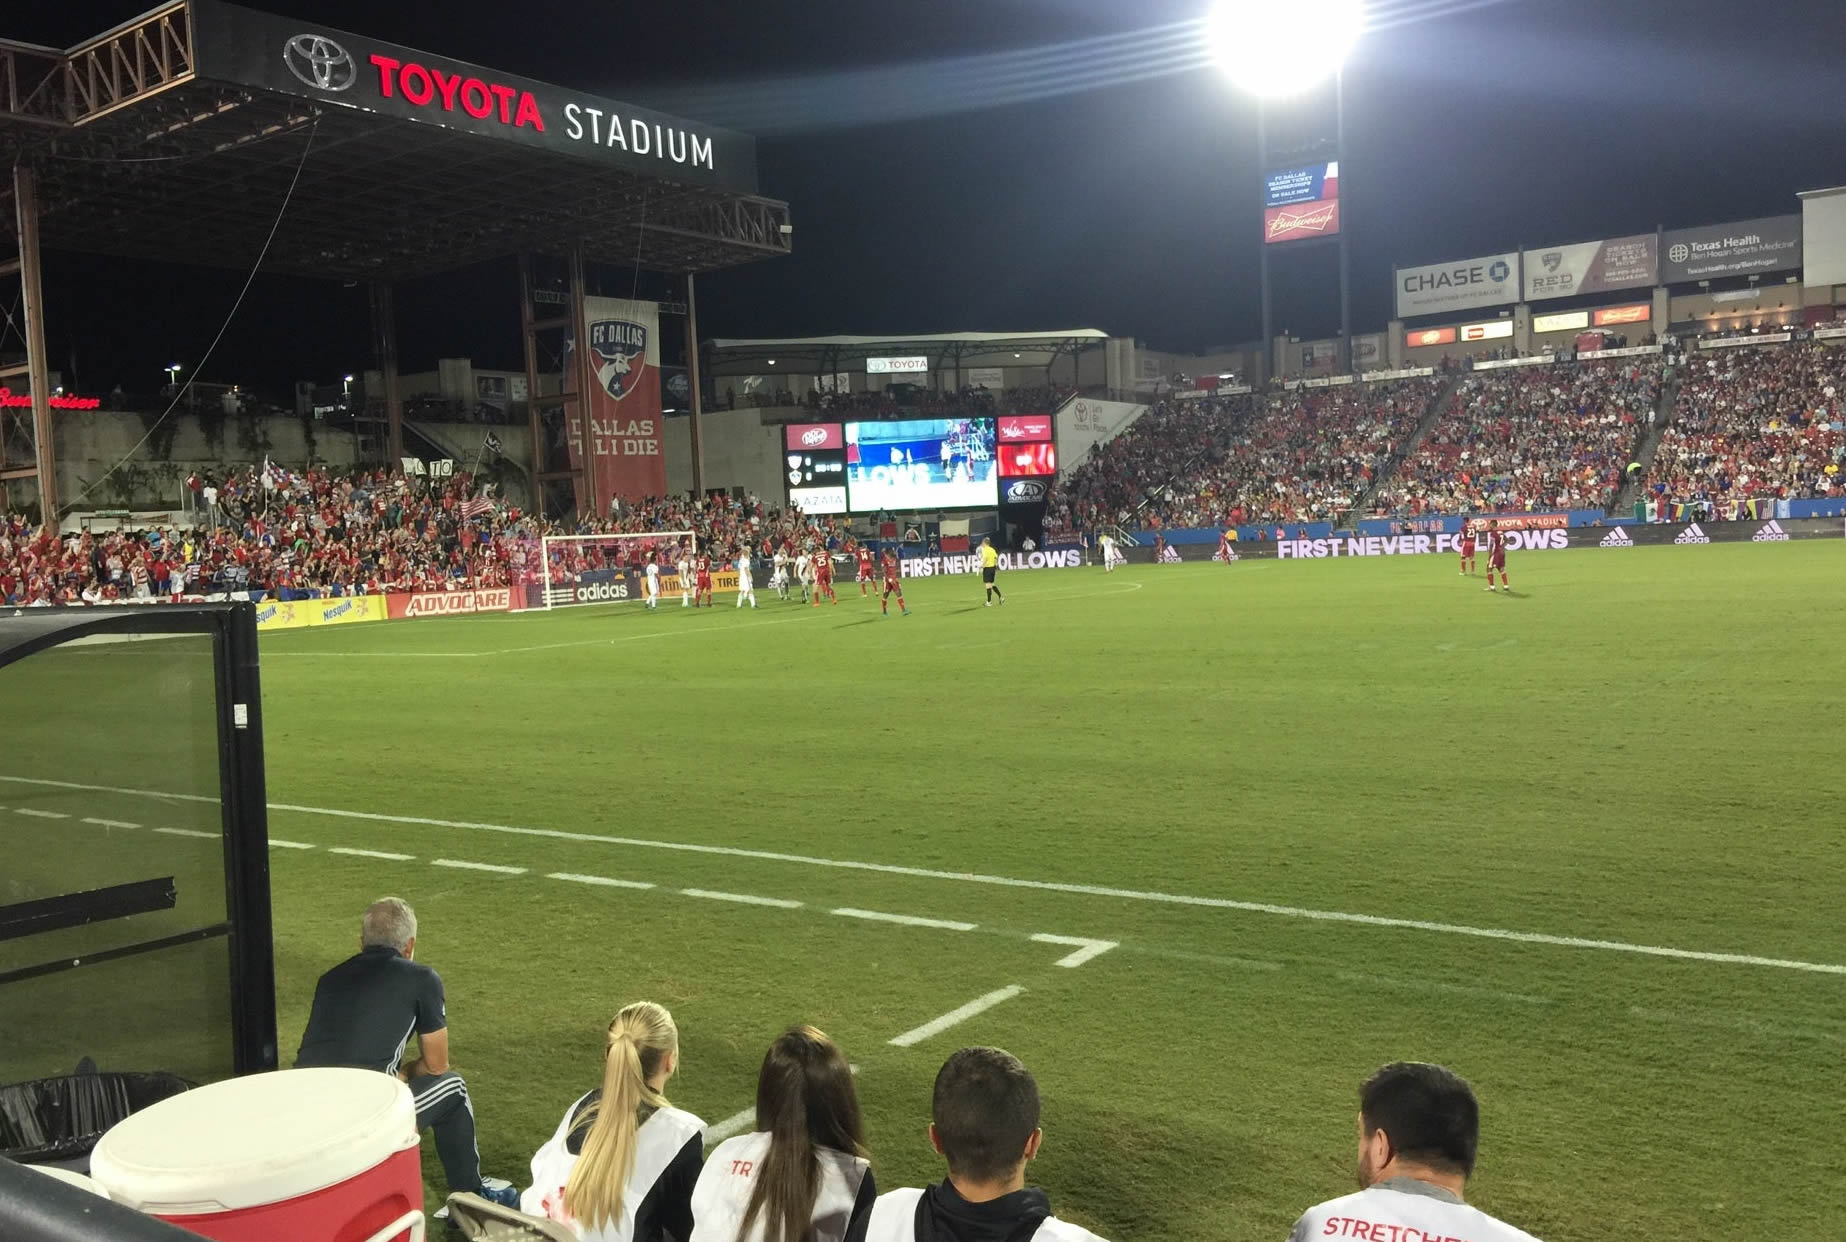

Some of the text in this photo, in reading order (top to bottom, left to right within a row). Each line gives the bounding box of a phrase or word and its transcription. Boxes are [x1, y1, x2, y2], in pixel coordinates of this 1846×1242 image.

[370, 54, 714, 170] TOYOTA STADIUM
[1690, 235, 1760, 252] Texas Health
[1404, 266, 1484, 292] CHASE
[1533, 273, 1573, 288] RED
[593, 325, 643, 347] FC DALLAS
[889, 360, 927, 369] TOYOTA
[624, 440, 658, 456] DIE
[1467, 528, 1475, 538] 23
[1674, 536, 1709, 544] adidas
[1752, 533, 1789, 542] adidas
[1278, 538, 1343, 559] FIRST
[1349, 534, 1430, 555] NEVER
[1600, 538, 1634, 547] adidas
[817, 557, 826, 567] 25
[901, 549, 1081, 578] FIRST NEVE OLLOWS
[577, 580, 628, 601] adidas
[323, 600, 352, 622] Nesquik
[405, 589, 510, 617] ADVOCARE
[256, 605, 277, 623] squik
